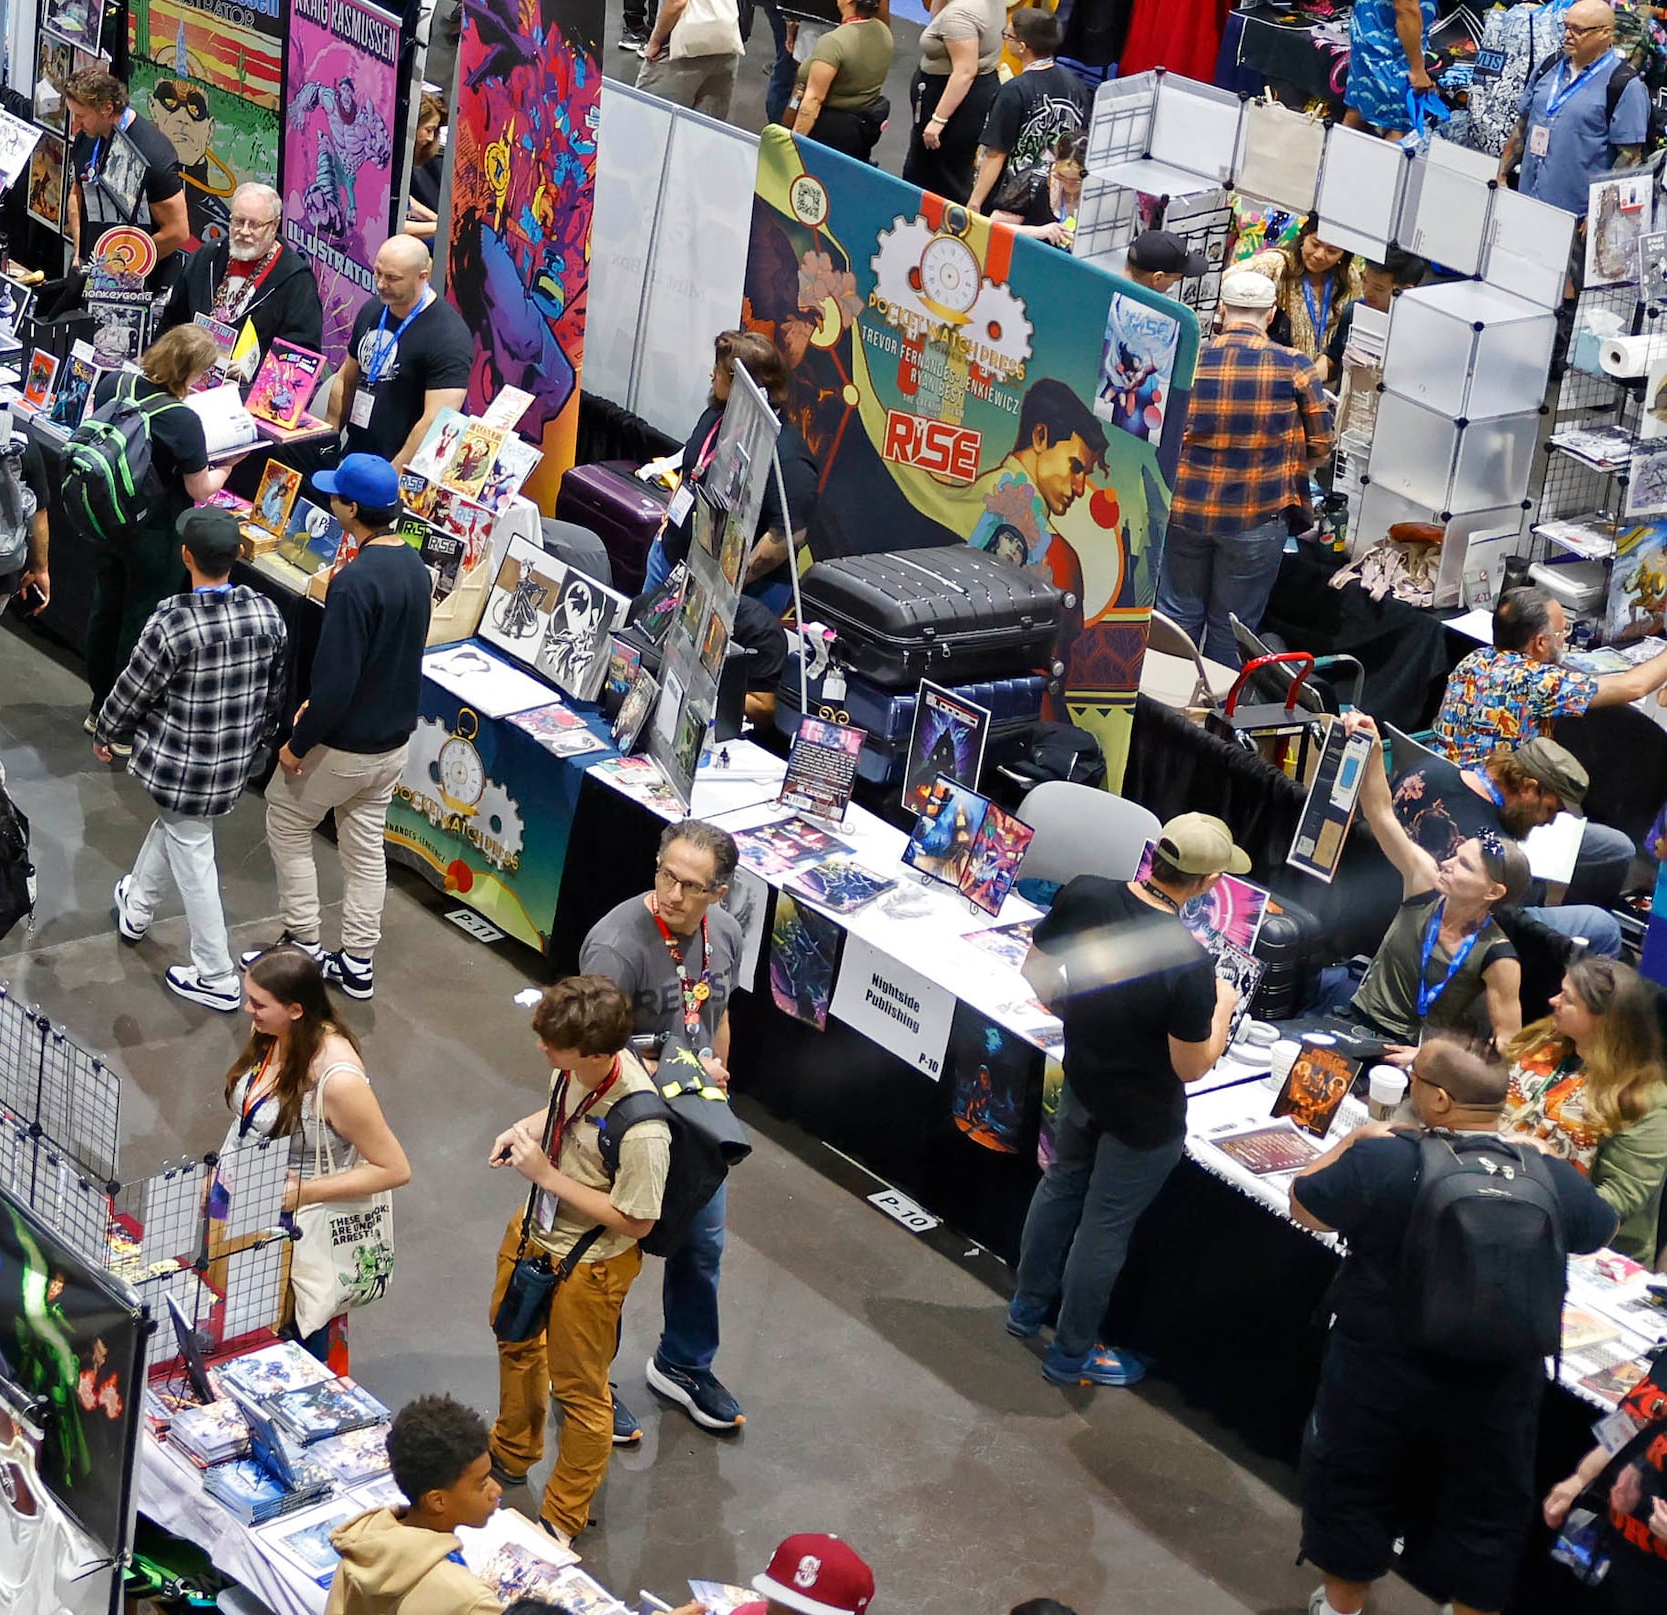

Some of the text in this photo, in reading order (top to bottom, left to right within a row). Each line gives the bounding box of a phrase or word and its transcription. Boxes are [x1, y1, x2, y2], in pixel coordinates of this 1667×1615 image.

[332, 7, 397, 62] RASMUSSEN
[869, 294, 1027, 379] POCKET WATCH PRESS
[862, 326, 1020, 415] TREVOR FERNANDES-JENKIEWICZ
[910, 366, 964, 404] RYAN BEST
[452, 912, 497, 940] P-11
[871, 971, 921, 1013] Nightside
[865, 989, 921, 1034] Publishing
[918, 1052, 938, 1073] P-10
[328, 1216, 360, 1231] THESE
[878, 1194, 931, 1229] P-10
[332, 1229, 375, 1247] ARREST!
